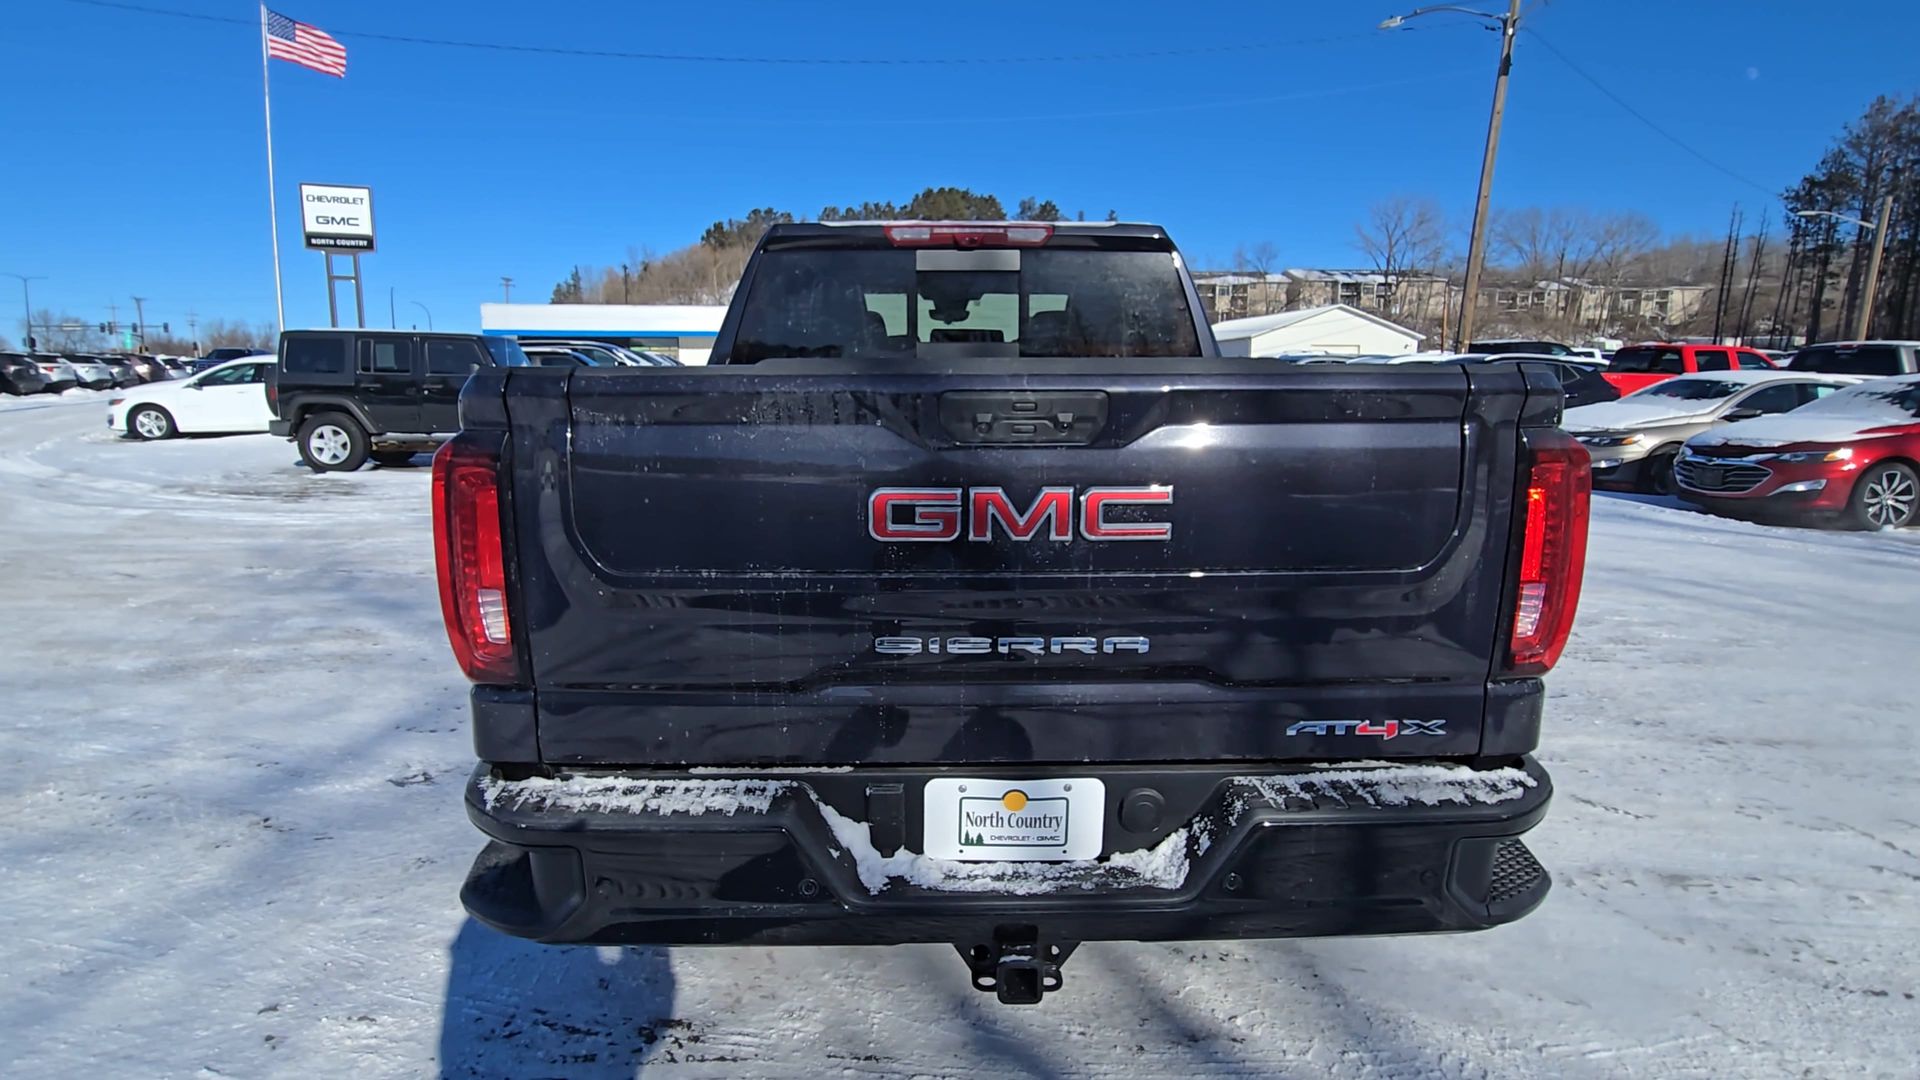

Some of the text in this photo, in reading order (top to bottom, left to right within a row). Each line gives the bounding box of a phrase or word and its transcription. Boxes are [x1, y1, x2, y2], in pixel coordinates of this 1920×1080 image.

[306, 194, 364, 205] CHEVROLET
[316, 215, 359, 226] GMC
[311, 238, 368, 247] NORTH COUNTRY
[868, 486, 1173, 541] GMC
[875, 636, 1149, 654] SIERRA
[1286, 719, 1447, 740] AT4X
[966, 811, 1063, 832] North Country
